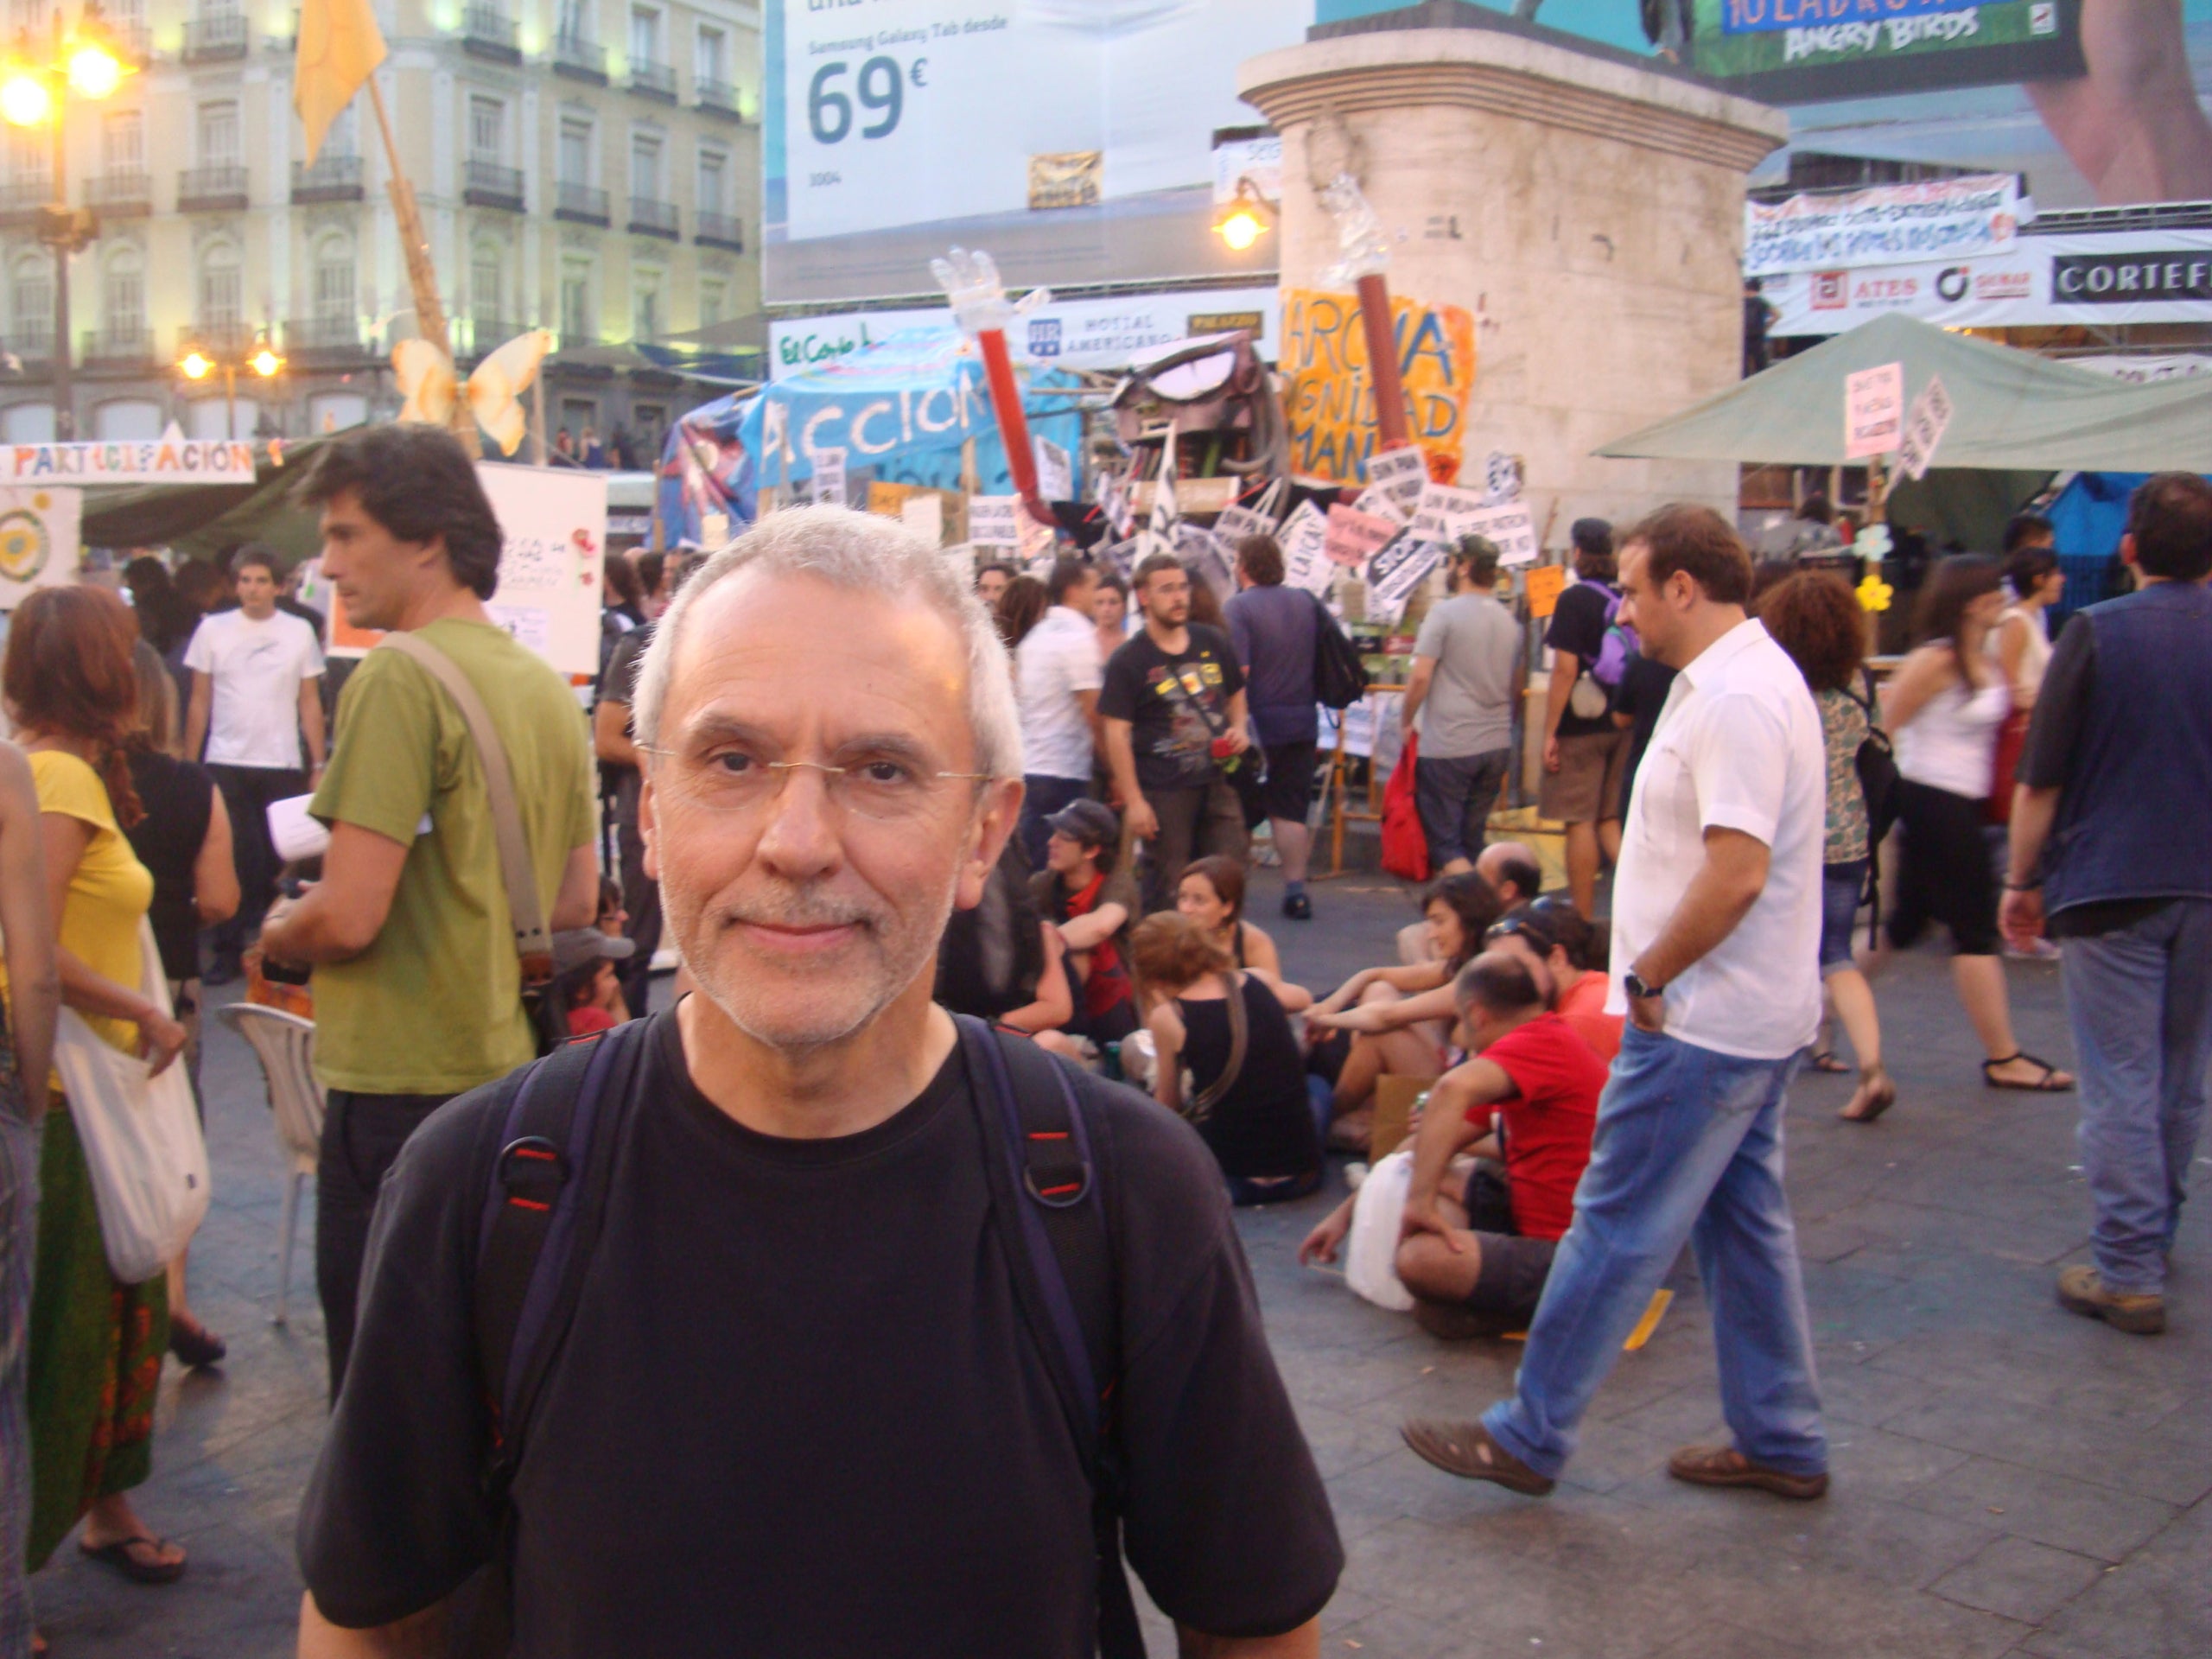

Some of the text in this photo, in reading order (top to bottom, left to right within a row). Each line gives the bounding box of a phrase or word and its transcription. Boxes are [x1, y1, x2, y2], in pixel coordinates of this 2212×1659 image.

[876, 27, 930, 46] Galaxy
[931, 21, 960, 38] Tab
[963, 15, 1008, 32] desde
[1783, 6, 1980, 63] ANGRY BIRDS
[1853, 277, 1919, 300] ATES
[2056, 261, 2212, 295] CORTEF
